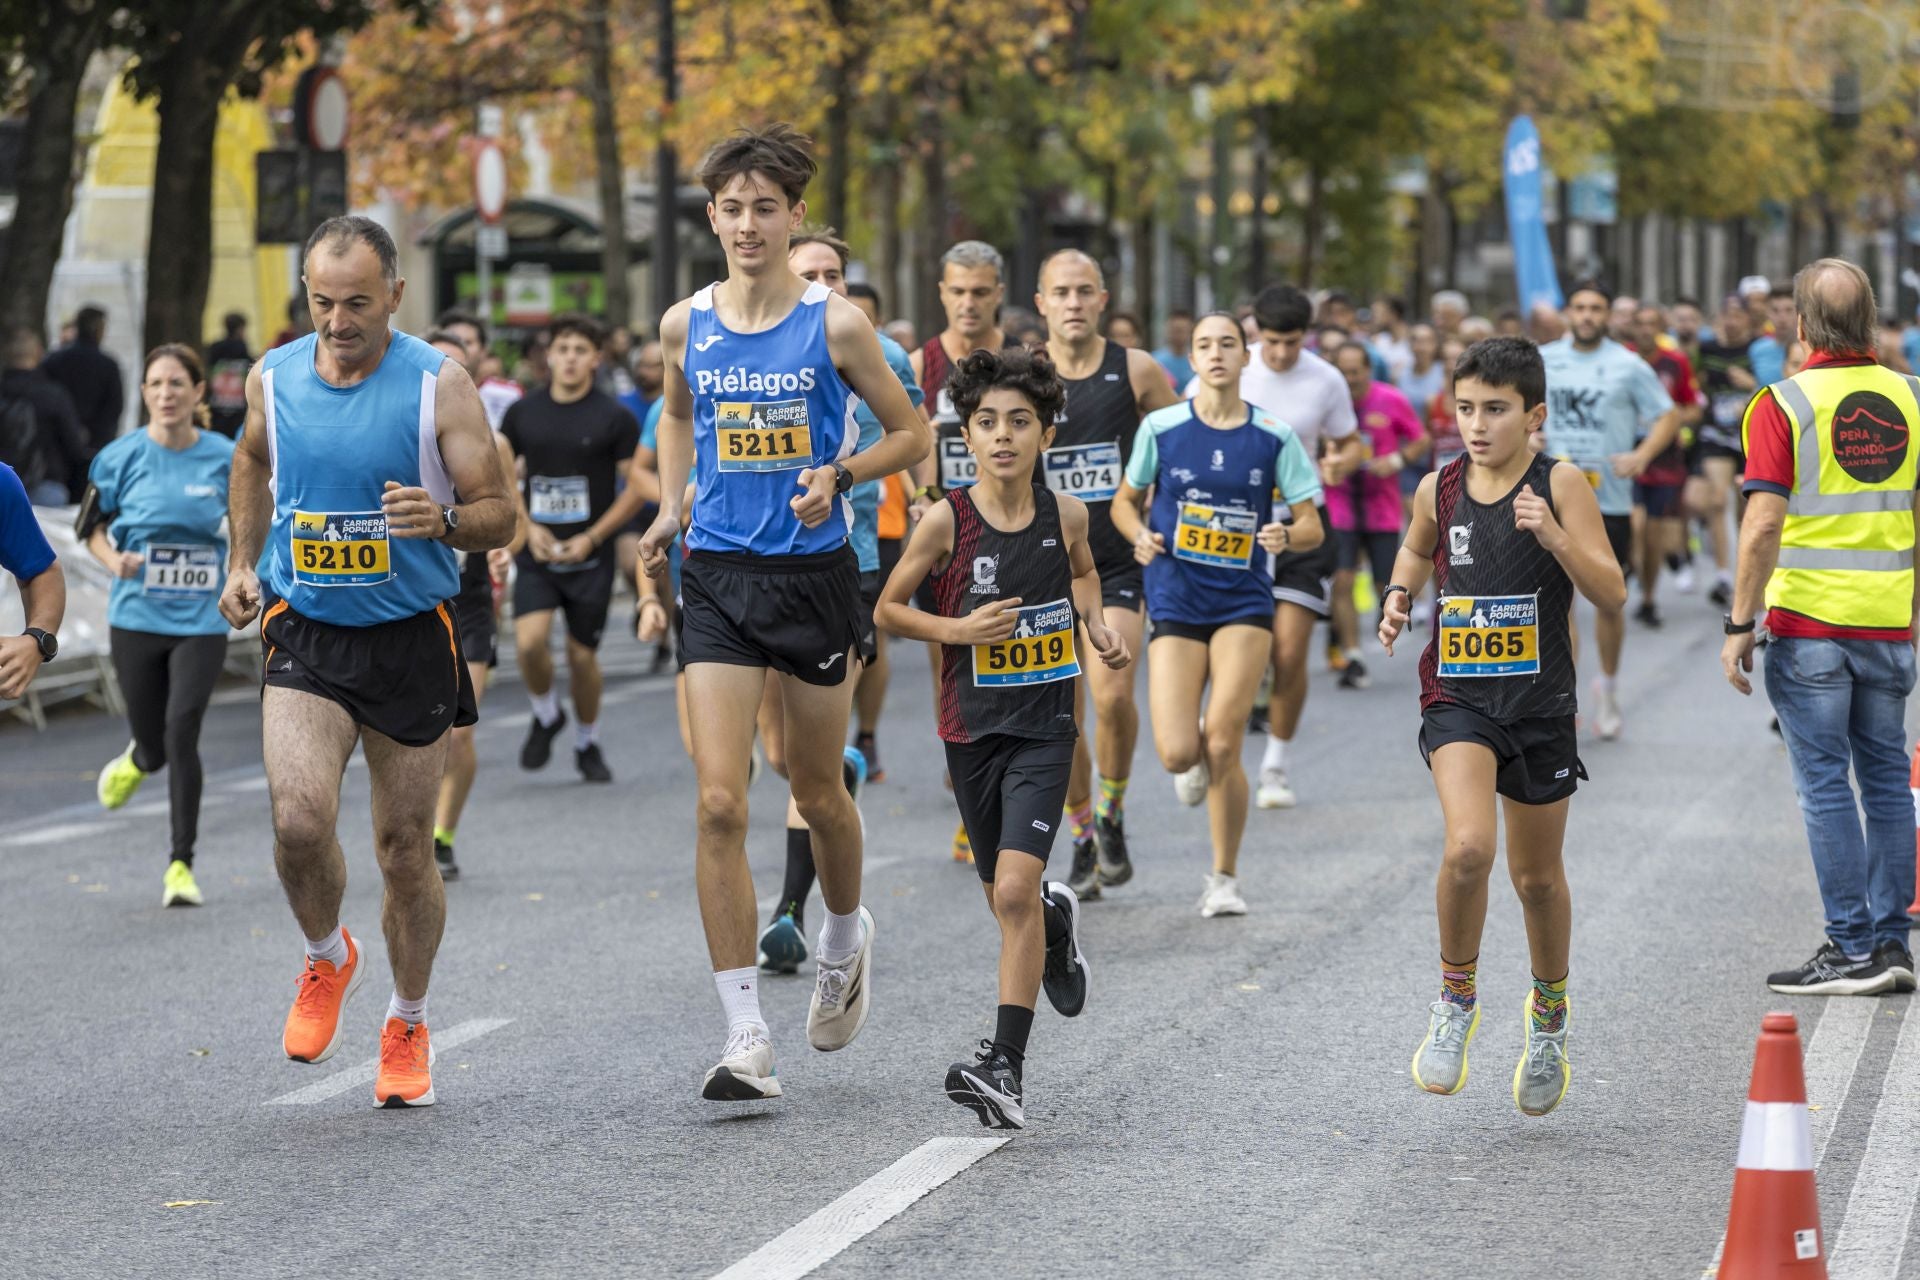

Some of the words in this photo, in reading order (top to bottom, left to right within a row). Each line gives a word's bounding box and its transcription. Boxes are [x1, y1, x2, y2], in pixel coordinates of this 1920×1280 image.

[696, 366, 816, 396] PiélagoS
[726, 411, 740, 420] 5K
[766, 406, 806, 415] CARRERA
[766, 412, 807, 422] POPULAR
[1840, 428, 1870, 441] PEÑA
[729, 432, 797, 457] 5211
[1844, 444, 1886, 457] FONDO
[1059, 468, 1113, 490] 1074
[300, 521, 313, 531] 5K
[343, 519, 385, 527] CARRERA
[342, 526, 385, 534] POPULAR
[1186, 530, 1244, 554] 5127
[303, 544, 376, 569] 5210
[158, 568, 209, 587] 1100
[1035, 607, 1070, 621] CARRERA
[1447, 607, 1460, 617] 5K
[1490, 603, 1535, 612] CARRERA
[1034, 614, 1070, 629] POPULAR
[1489, 610, 1535, 620] POPULAR
[1058, 621, 1070, 631] DM
[1519, 618, 1534, 626] DM
[1448, 631, 1525, 658] 5065
[989, 636, 1064, 669] 5019
